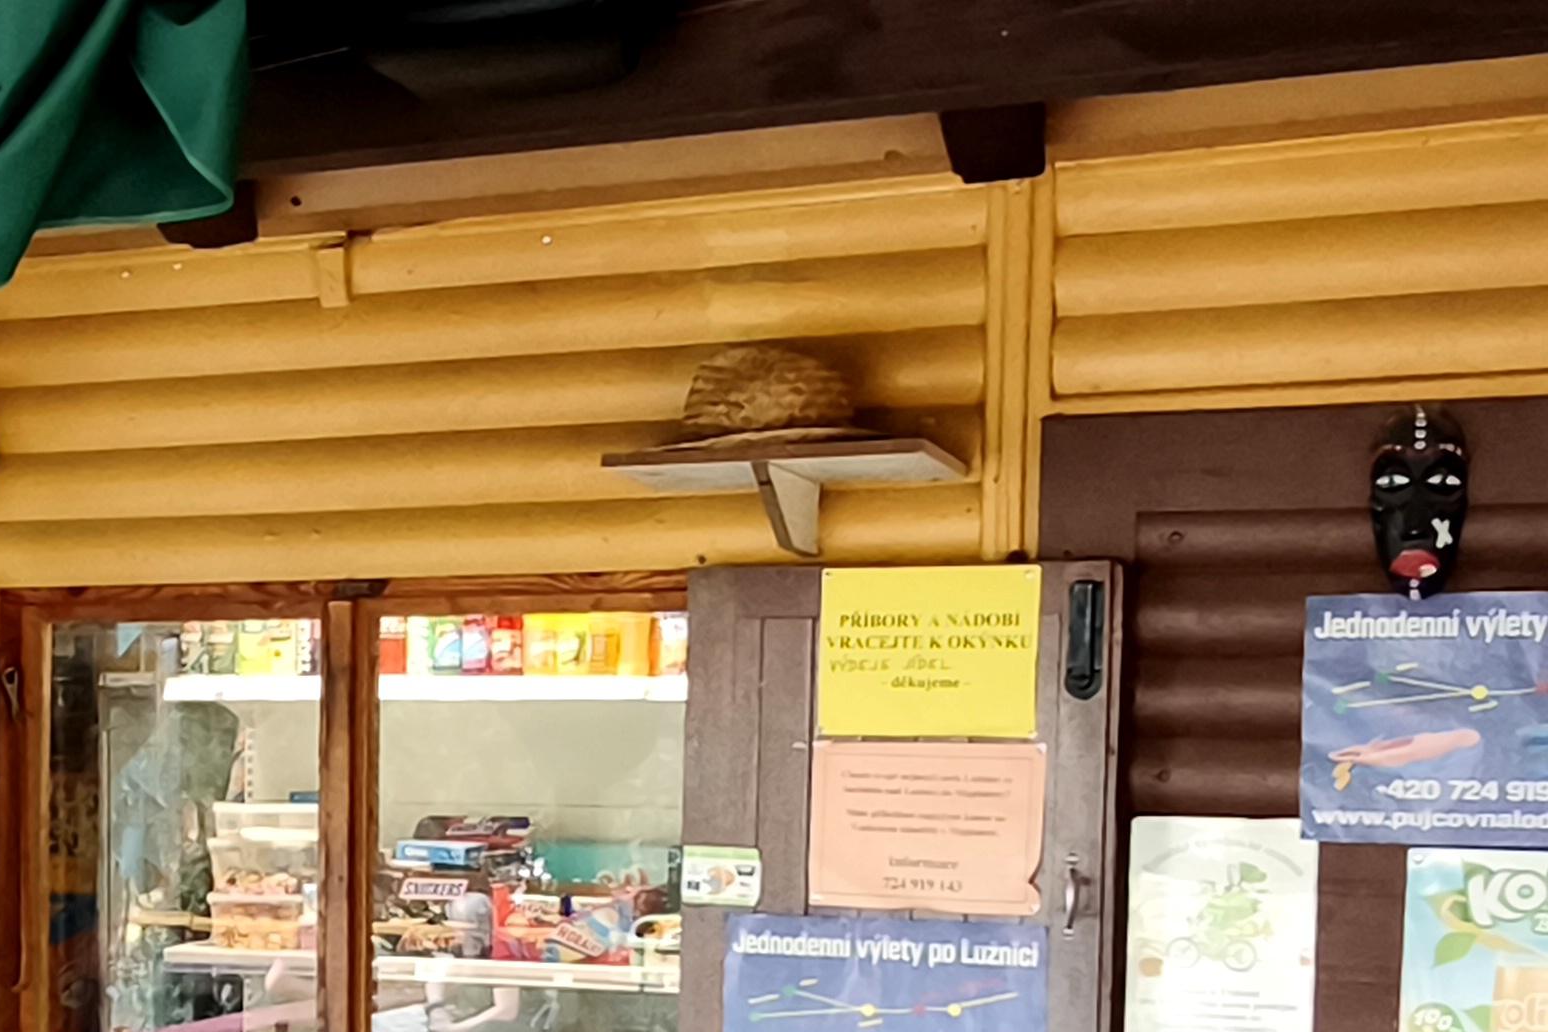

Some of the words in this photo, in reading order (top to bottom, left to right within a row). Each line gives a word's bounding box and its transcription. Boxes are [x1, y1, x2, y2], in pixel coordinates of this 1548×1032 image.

[839, 610, 920, 628] PŘÍBORY
[946, 611, 1021, 627] NÁDOBÍ
[1313, 608, 1460, 640] Jednodenní
[1464, 607, 1548, 644] výlety
[826, 635, 925, 650] VRACEJTE
[929, 635, 943, 649] K
[947, 631, 1032, 650] OKÝNKU
[890, 676, 960, 691] děkujeme
[1447, 780, 1499, 801] 724
[1505, 780, 1548, 802] 919
[403, 882, 464, 897] SNICKERS
[883, 876, 907, 890] 724
[910, 879, 935, 891] 919
[732, 928, 851, 959] Jednodenní
[854, 932, 924, 967] výlety
[928, 943, 956, 968] po
